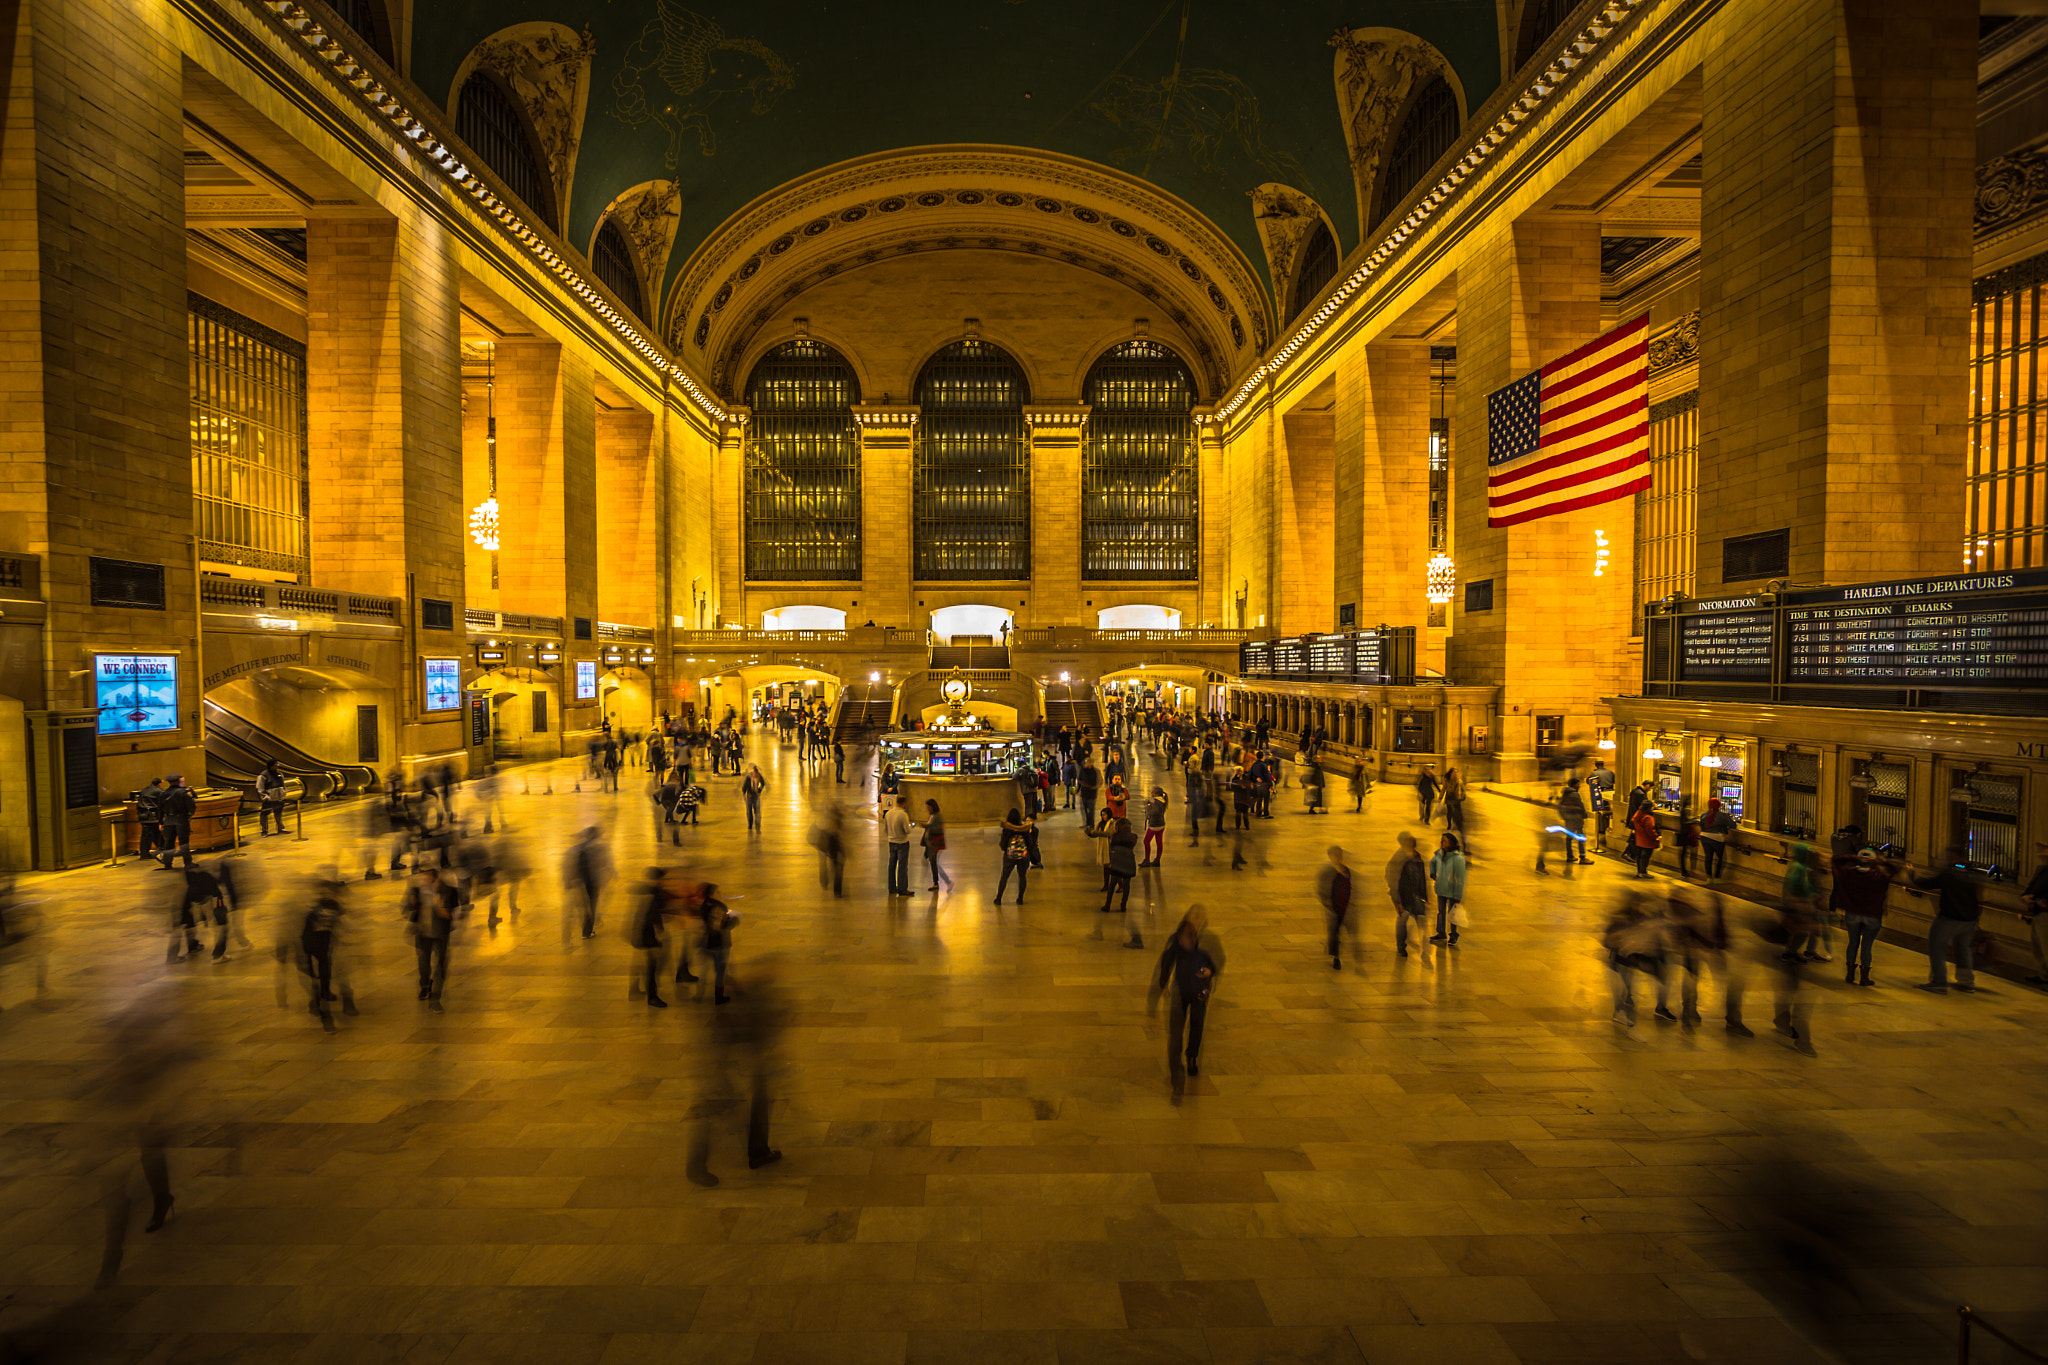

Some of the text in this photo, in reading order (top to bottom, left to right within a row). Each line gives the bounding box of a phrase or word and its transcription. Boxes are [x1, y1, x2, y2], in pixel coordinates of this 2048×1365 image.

[1844, 576, 2014, 599] HARLEM LINE DEPARTURES
[1699, 598, 1756, 610] INFORMATION
[1834, 606, 1892, 617] DESTINATION
[1905, 602, 1953, 613] REMARKS
[1836, 620, 1871, 629] SOUTHEAST
[1907, 616, 1953, 626] CONNECTION
[1957, 615, 1967, 624] TO
[1971, 613, 2008, 623] WASSAIC
[1715, 627, 1738, 636] packages
[1740, 625, 1771, 633] unattended
[1870, 632, 1895, 640] PLAINS
[1907, 630, 1939, 638] FORDHAM
[1953, 629, 1966, 637] 1ST
[1971, 628, 1992, 637] STOP
[1736, 646, 1767, 654] Department
[1870, 644, 1895, 652] PLAINS
[1906, 642, 1939, 651] MELROSE
[1952, 642, 1966, 650] 1ST
[1970, 641, 1992, 650] STOP
[1736, 657, 1771, 665] cooperation
[1906, 655, 1929, 663] WHITE
[1932, 655, 1961, 663] PLAINS
[1976, 655, 1991, 663] 1ST
[1995, 654, 2017, 663] STOP
[103, 664, 167, 674] WE CONNECT
[203, 653, 300, 687] THE METLIFE BUILDING
[346, 658, 371, 672] STREET
[1869, 667, 1894, 675] PLAINS
[1905, 668, 1937, 676] FORDHAM
[1969, 668, 1991, 676] STOP
